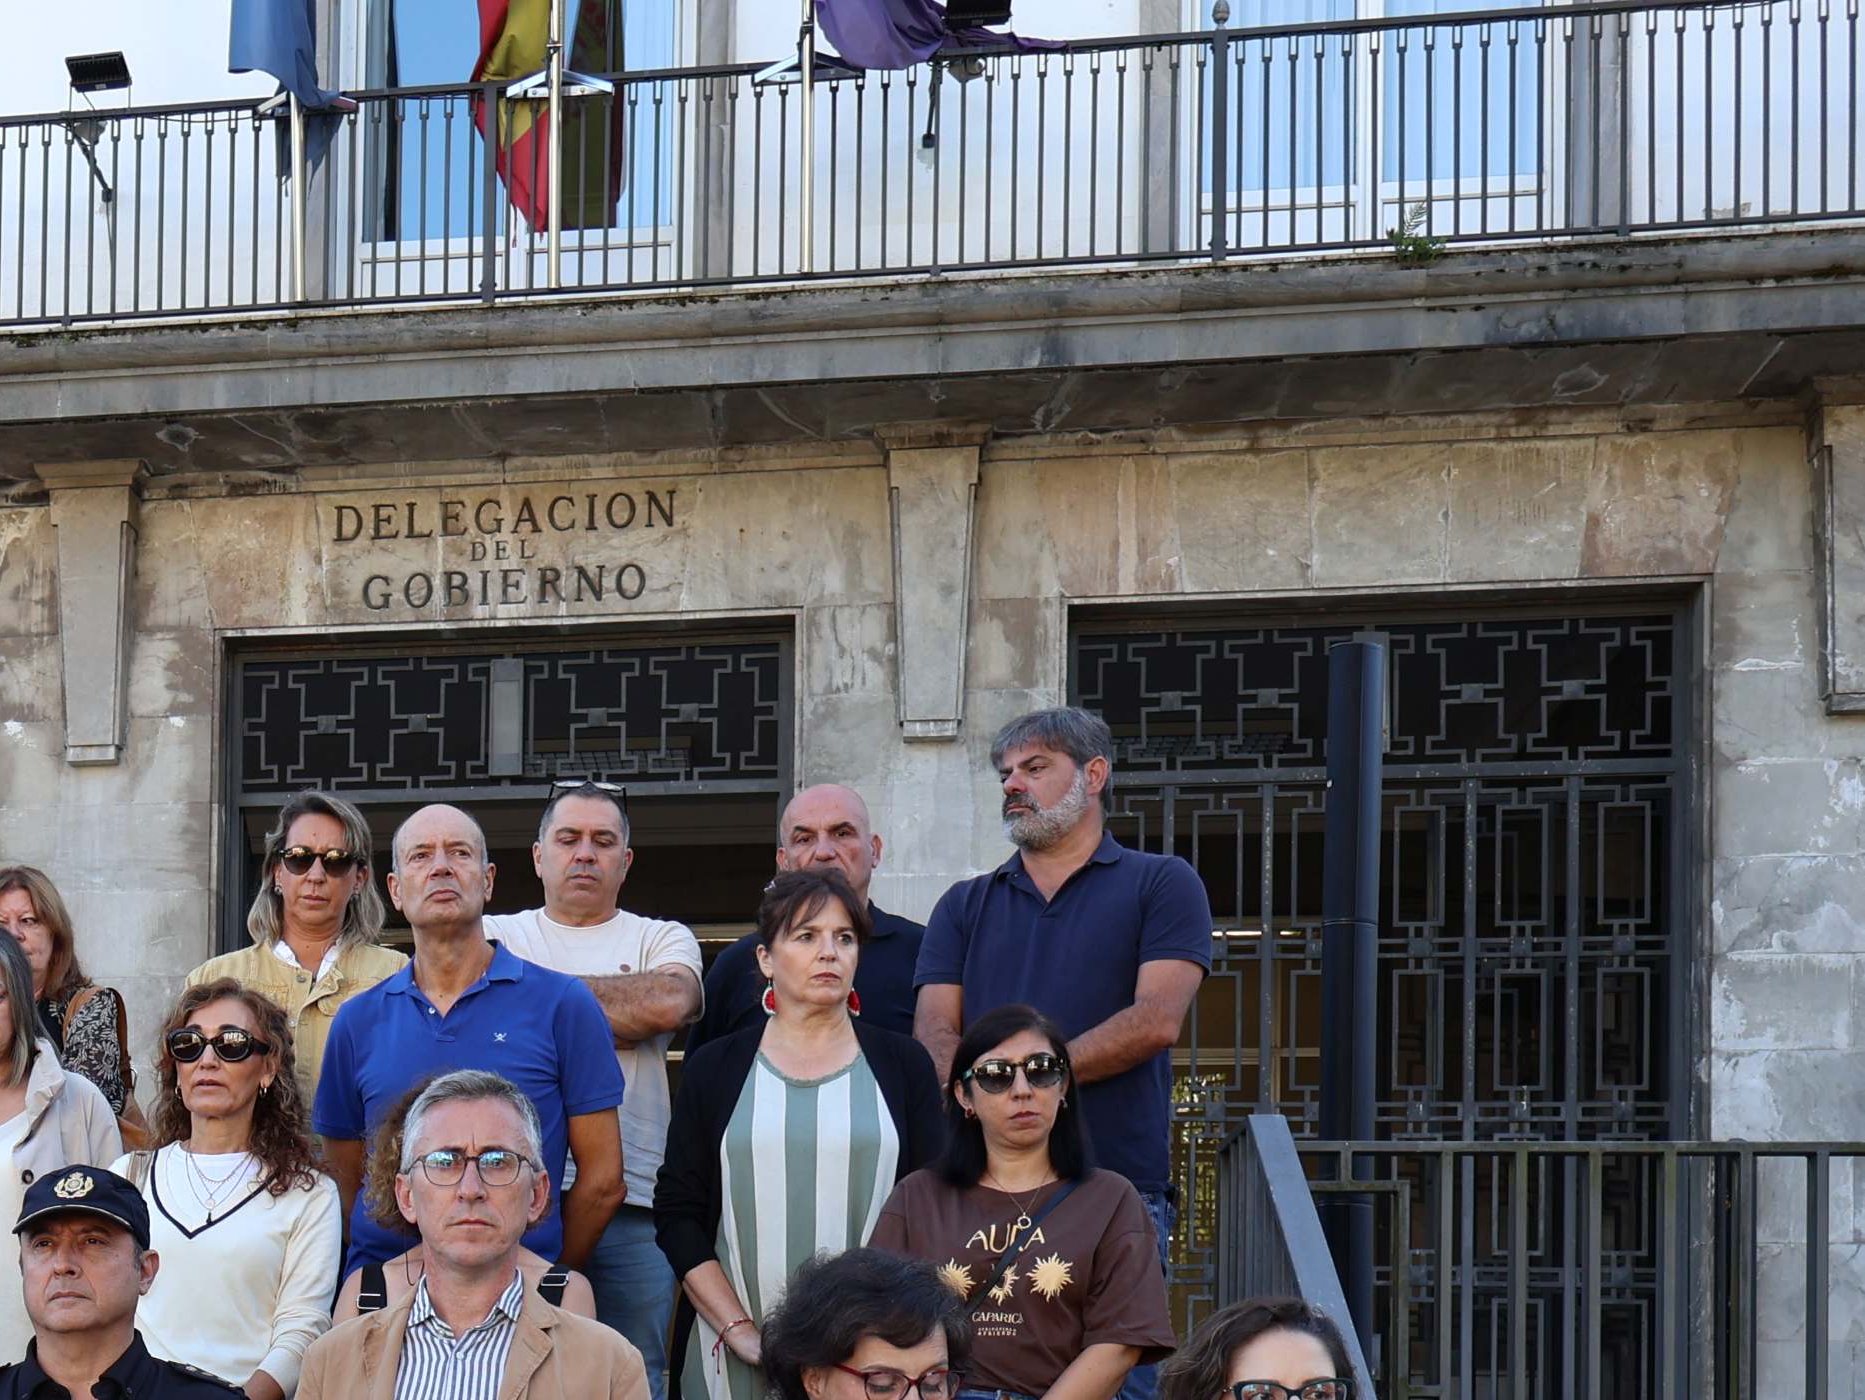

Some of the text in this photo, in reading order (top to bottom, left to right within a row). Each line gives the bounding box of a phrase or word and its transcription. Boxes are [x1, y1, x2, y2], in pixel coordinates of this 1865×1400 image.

[334, 489, 677, 543] DELEGACION
[470, 539, 535, 563] DEL
[362, 564, 647, 611] GOBIERNO
